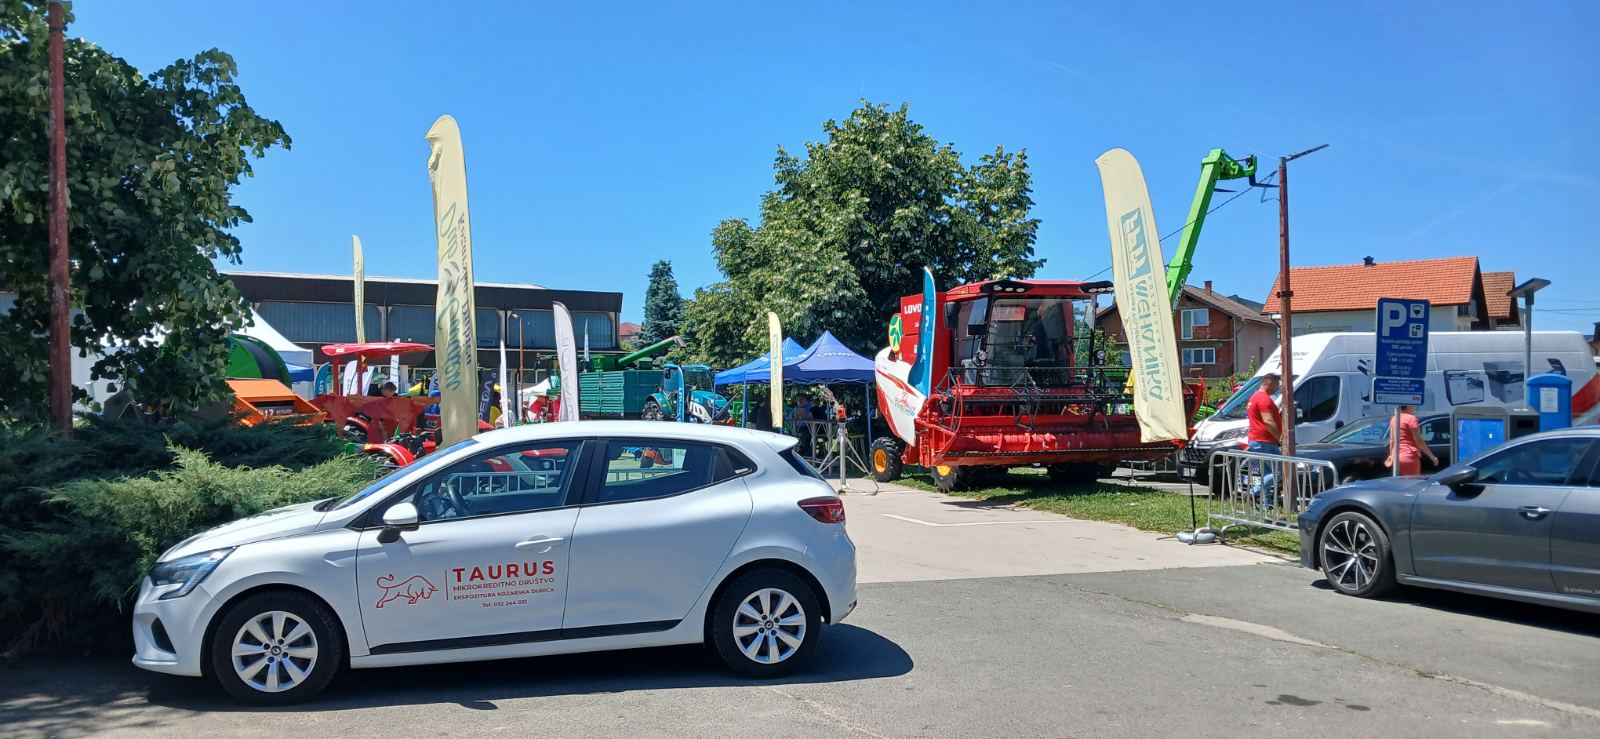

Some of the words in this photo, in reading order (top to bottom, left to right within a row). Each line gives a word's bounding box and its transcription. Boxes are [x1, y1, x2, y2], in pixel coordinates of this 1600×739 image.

[904, 303, 922, 315] LOVO
[1382, 302, 1407, 336] P
[452, 561, 554, 582] TAURUS
[453, 581, 517, 592] MIKROKREDITNO
[519, 576, 555, 587] DRUŠTVO
[453, 592, 496, 601] EKSPOZITURA
[497, 589, 530, 597] KOZARSKA
